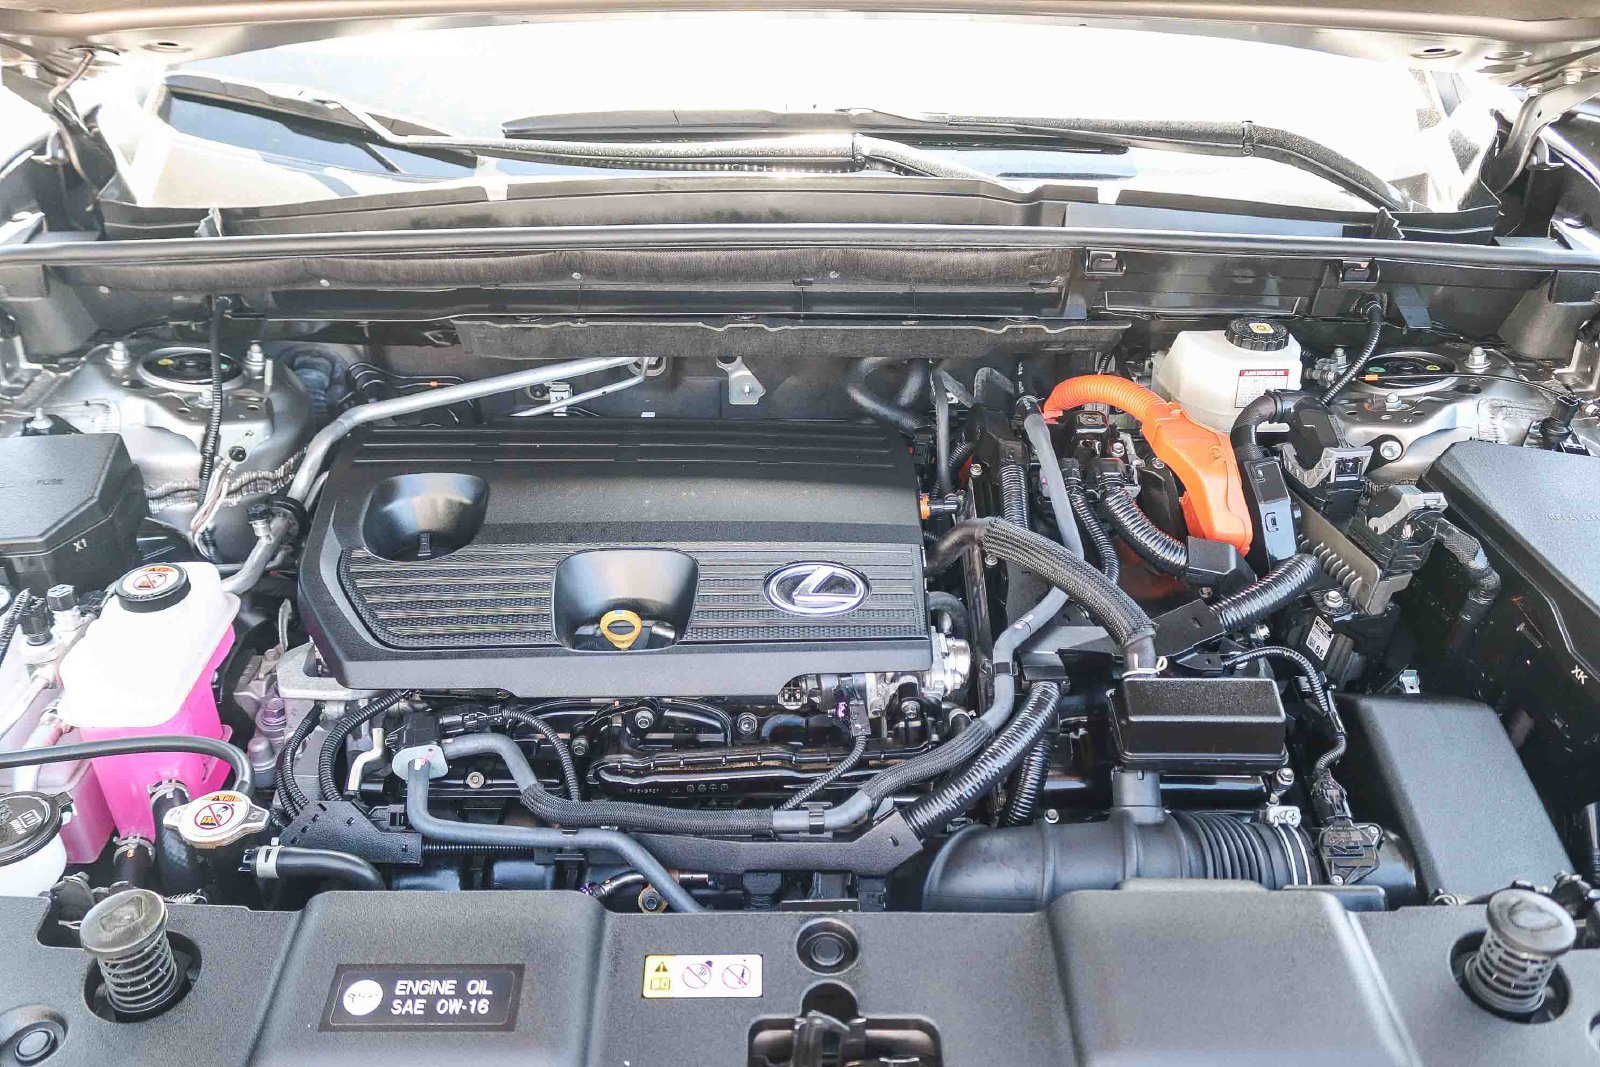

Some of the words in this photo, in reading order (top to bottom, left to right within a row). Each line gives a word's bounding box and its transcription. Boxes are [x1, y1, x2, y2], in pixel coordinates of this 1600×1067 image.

[1571, 664, 1588, 685] XK
[394, 979, 457, 996] ENGINE
[466, 979, 493, 995] OIL
[390, 998, 426, 1015] SAE
[436, 998, 490, 1015] 0W-16
